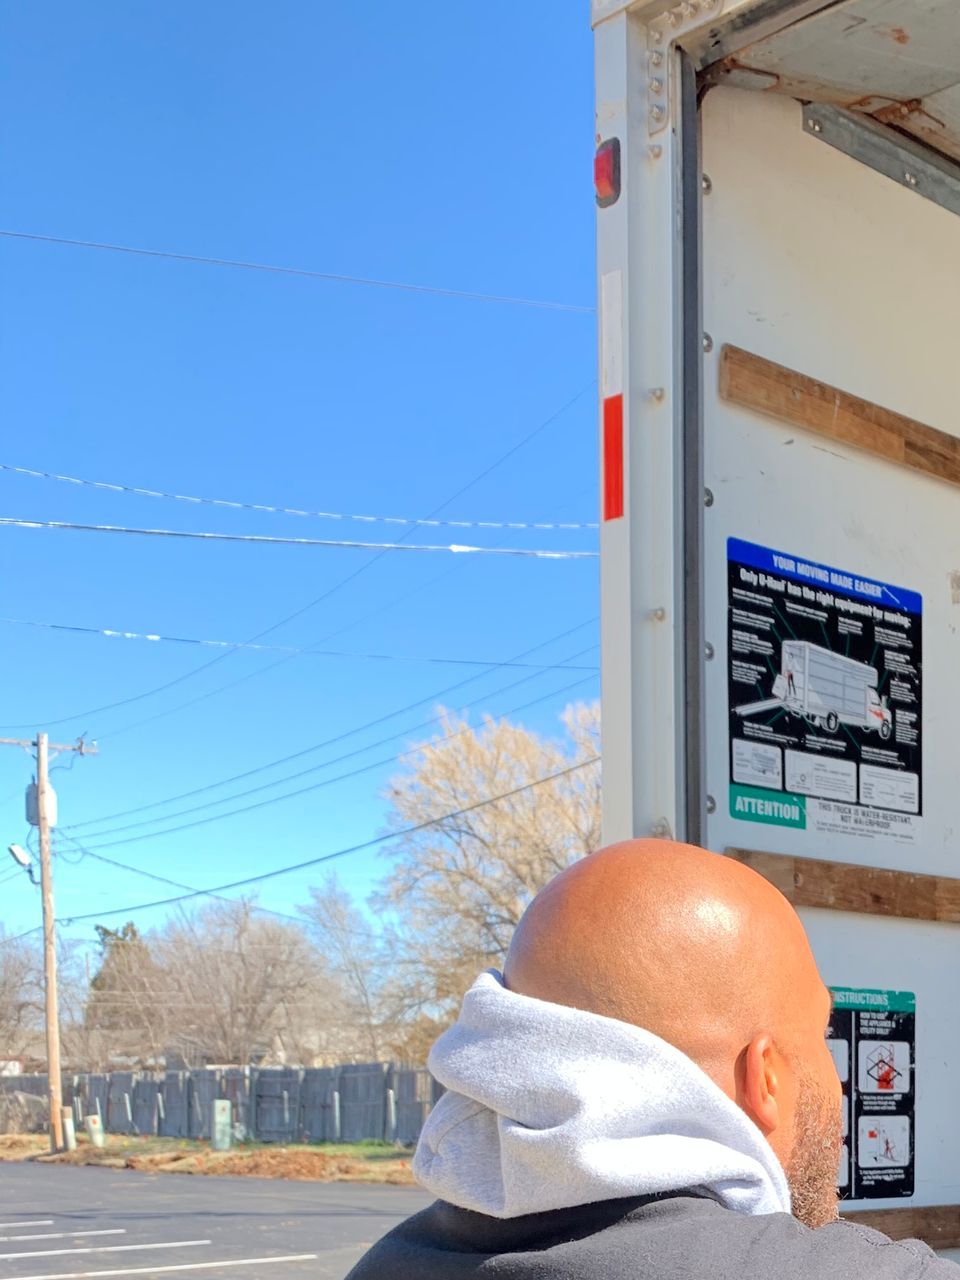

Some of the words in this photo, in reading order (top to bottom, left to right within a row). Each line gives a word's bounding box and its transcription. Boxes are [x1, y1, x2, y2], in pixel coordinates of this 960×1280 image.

[740, 567, 758, 586] Only
[787, 582, 802, 597] has
[802, 586, 815, 601] the
[816, 590, 834, 606] right
[835, 597, 873, 617] equipment
[772, 554, 795, 572] YOUR
[797, 562, 829, 583] MOVING
[831, 573, 853, 590] MADE
[855, 579, 882, 598] EASIER
[735, 796, 800, 820] ATTENTION
[818, 802, 832, 812] THIS
[834, 804, 851, 815] TRUCK
